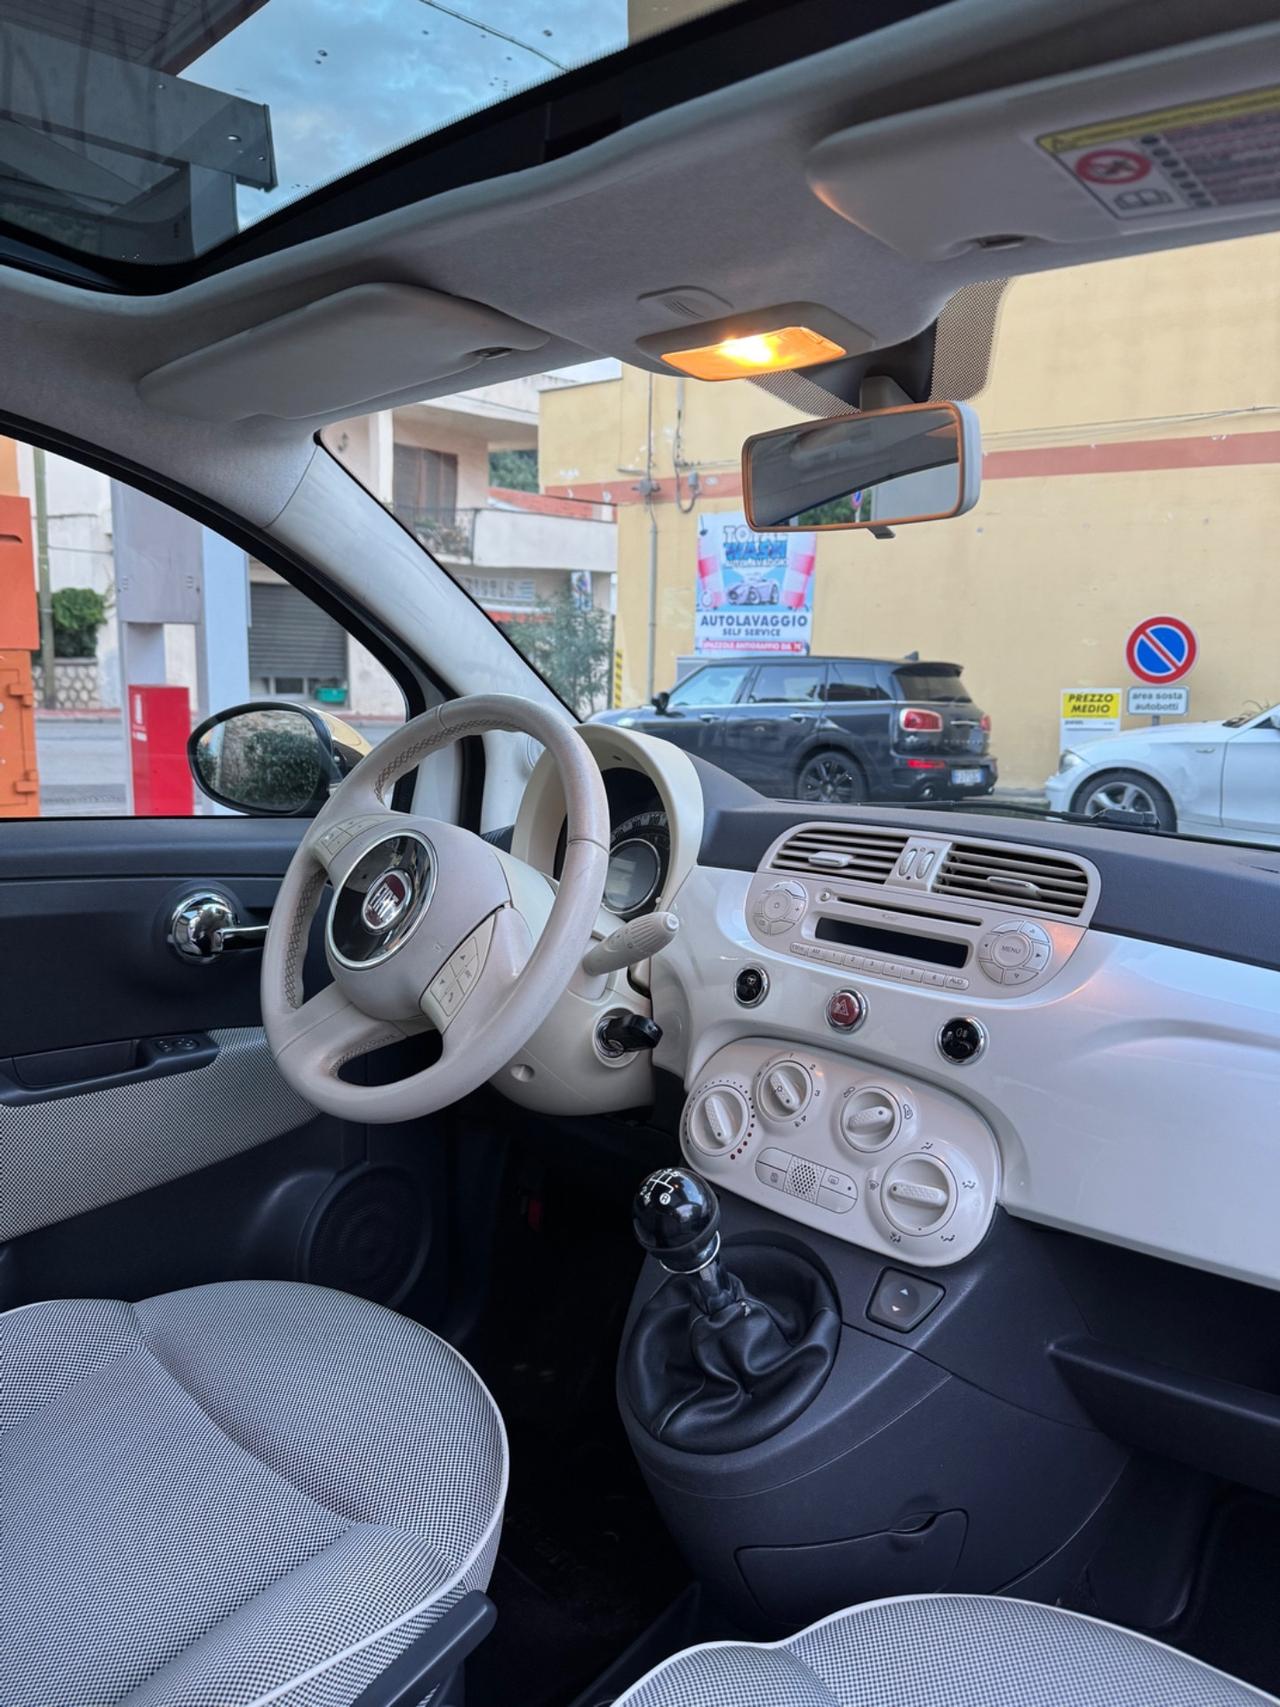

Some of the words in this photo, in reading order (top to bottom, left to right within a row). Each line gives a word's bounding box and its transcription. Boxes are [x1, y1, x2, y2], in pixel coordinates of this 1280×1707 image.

[700, 614, 808, 627] AUTOLAVAGGIO
[722, 628, 742, 636] SELF
[744, 628, 781, 637] SERVICE
[1068, 693, 1114, 703] PREZZO
[1155, 692, 1183, 700] sosta
[1071, 703, 1110, 713] MEDIO
[1134, 703, 1179, 711] autobotti
[1002, 944, 1022, 954] MENU
[814, 1089, 821, 1097] 3
